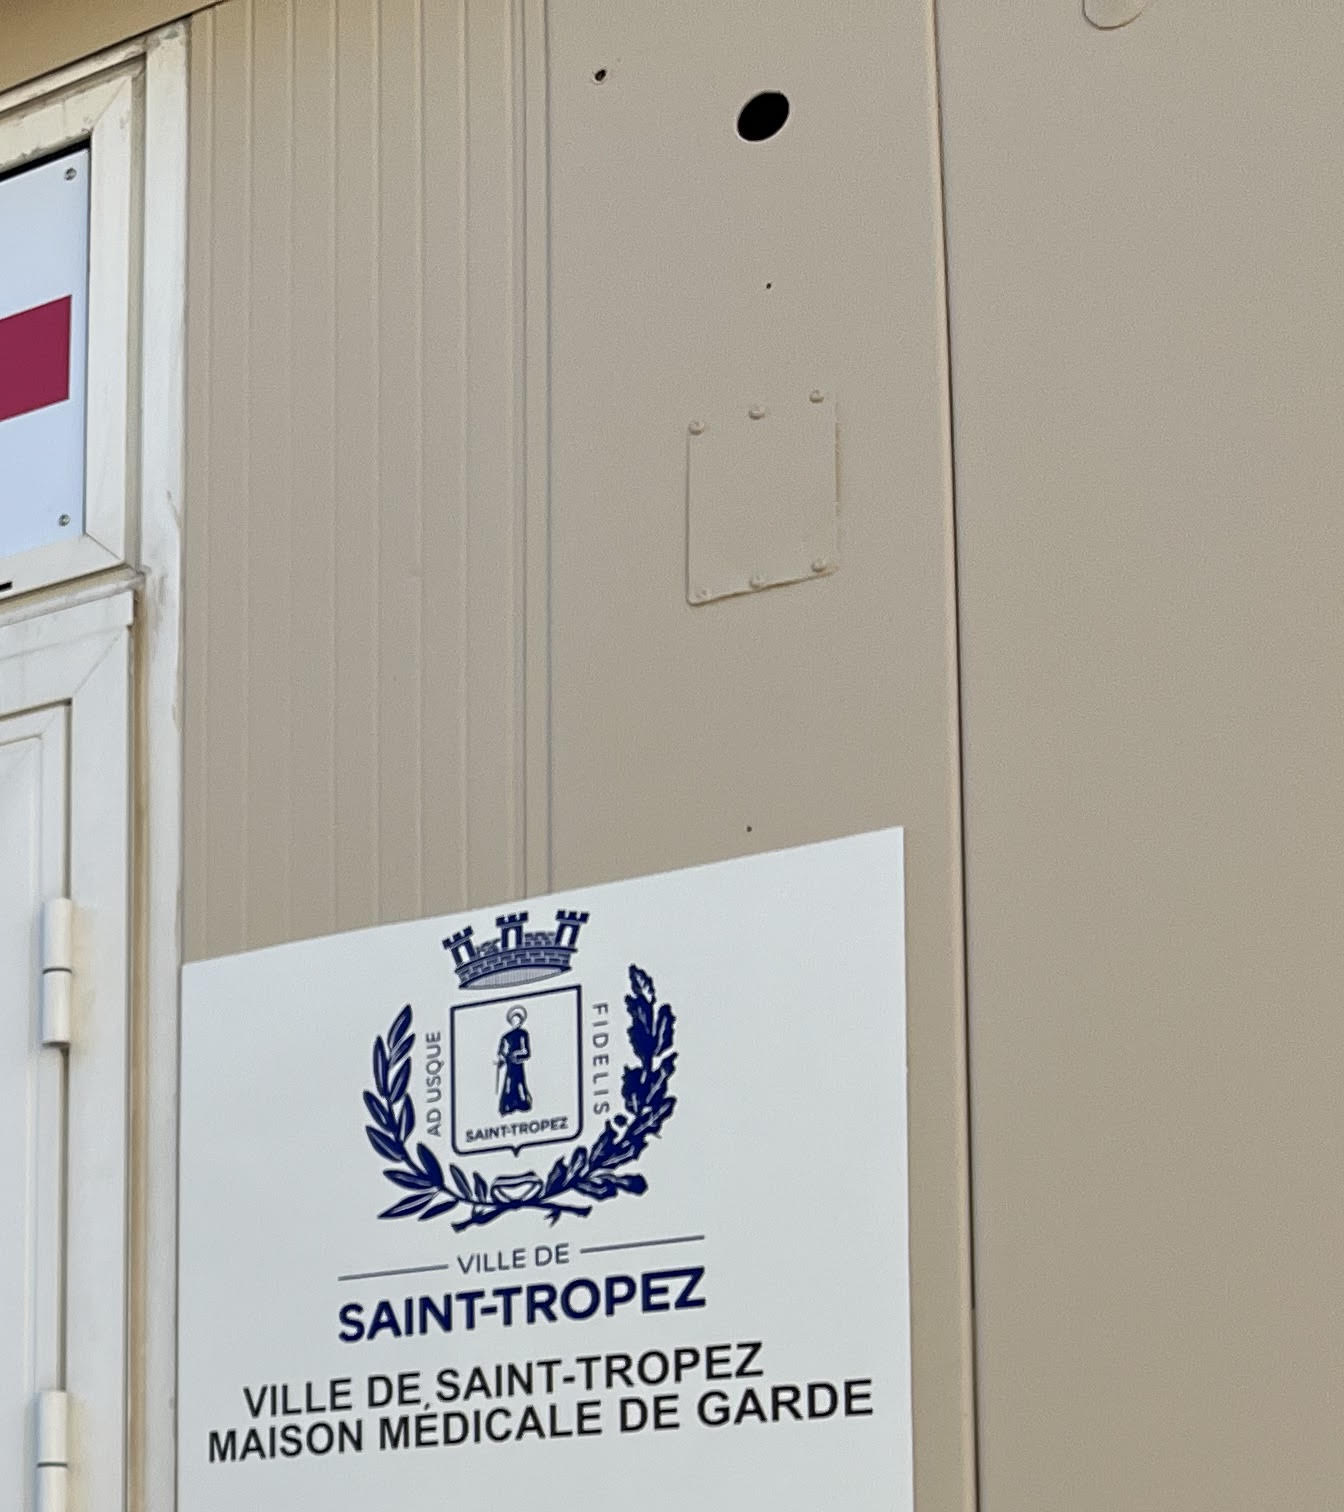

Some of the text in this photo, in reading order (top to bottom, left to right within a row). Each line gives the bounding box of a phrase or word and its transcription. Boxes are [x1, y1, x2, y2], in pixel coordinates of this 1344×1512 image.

[425, 1031, 445, 1137] AD USQUE
[592, 1002, 610, 1116] FIDELIS
[465, 1116, 569, 1144] SAINT-TROPEZ
[457, 1243, 570, 1274] VILLE DE
[338, 1265, 707, 1343] SAINT-TROPEZ
[243, 1341, 765, 1419] VILLE DE SAINT-TROPEZ
[209, 1378, 874, 1463] MAISON MÉDICALE DE GARDE
